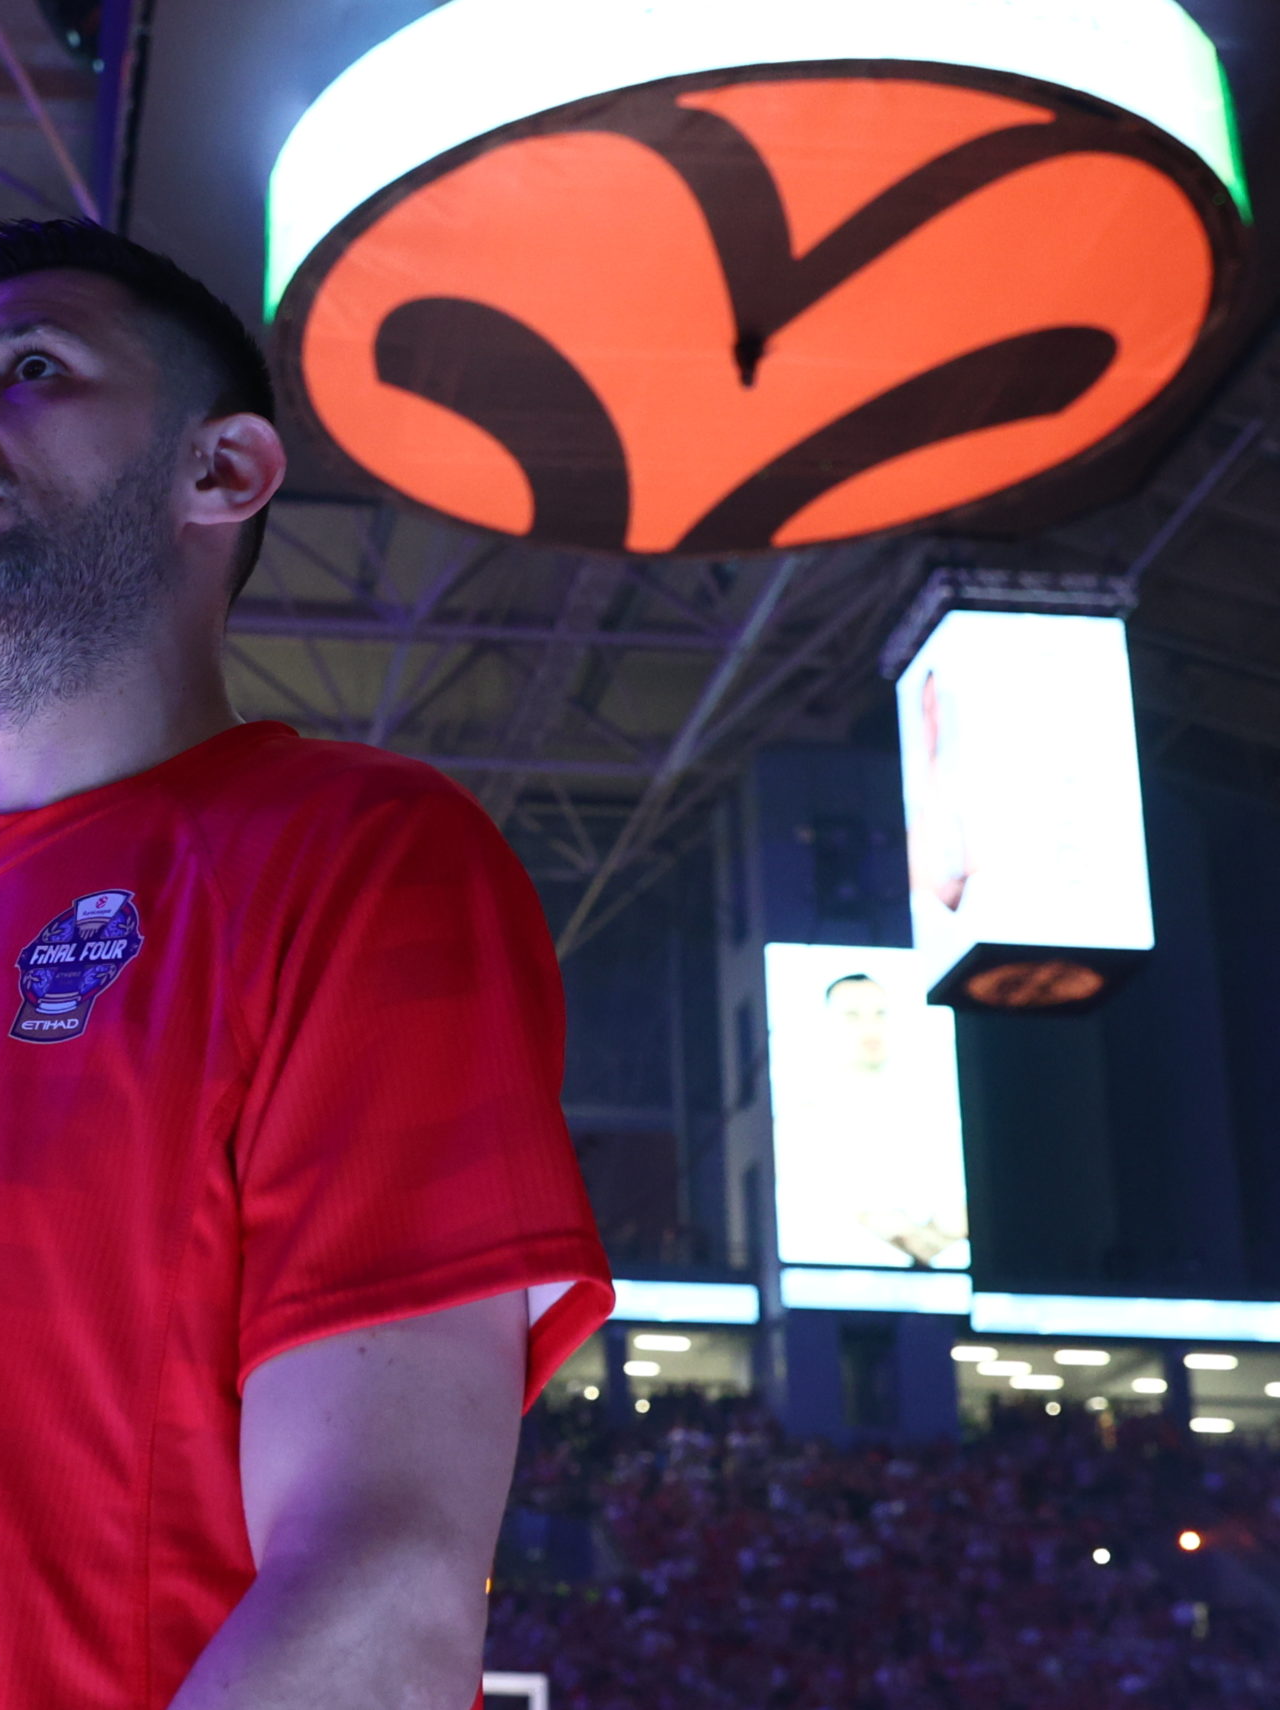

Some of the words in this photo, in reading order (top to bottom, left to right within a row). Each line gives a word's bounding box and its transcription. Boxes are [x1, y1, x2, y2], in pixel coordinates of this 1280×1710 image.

[29, 943, 78, 965] FINAL
[79, 939, 128, 961] FOUR
[21, 1018, 79, 1031] ETIHAD
